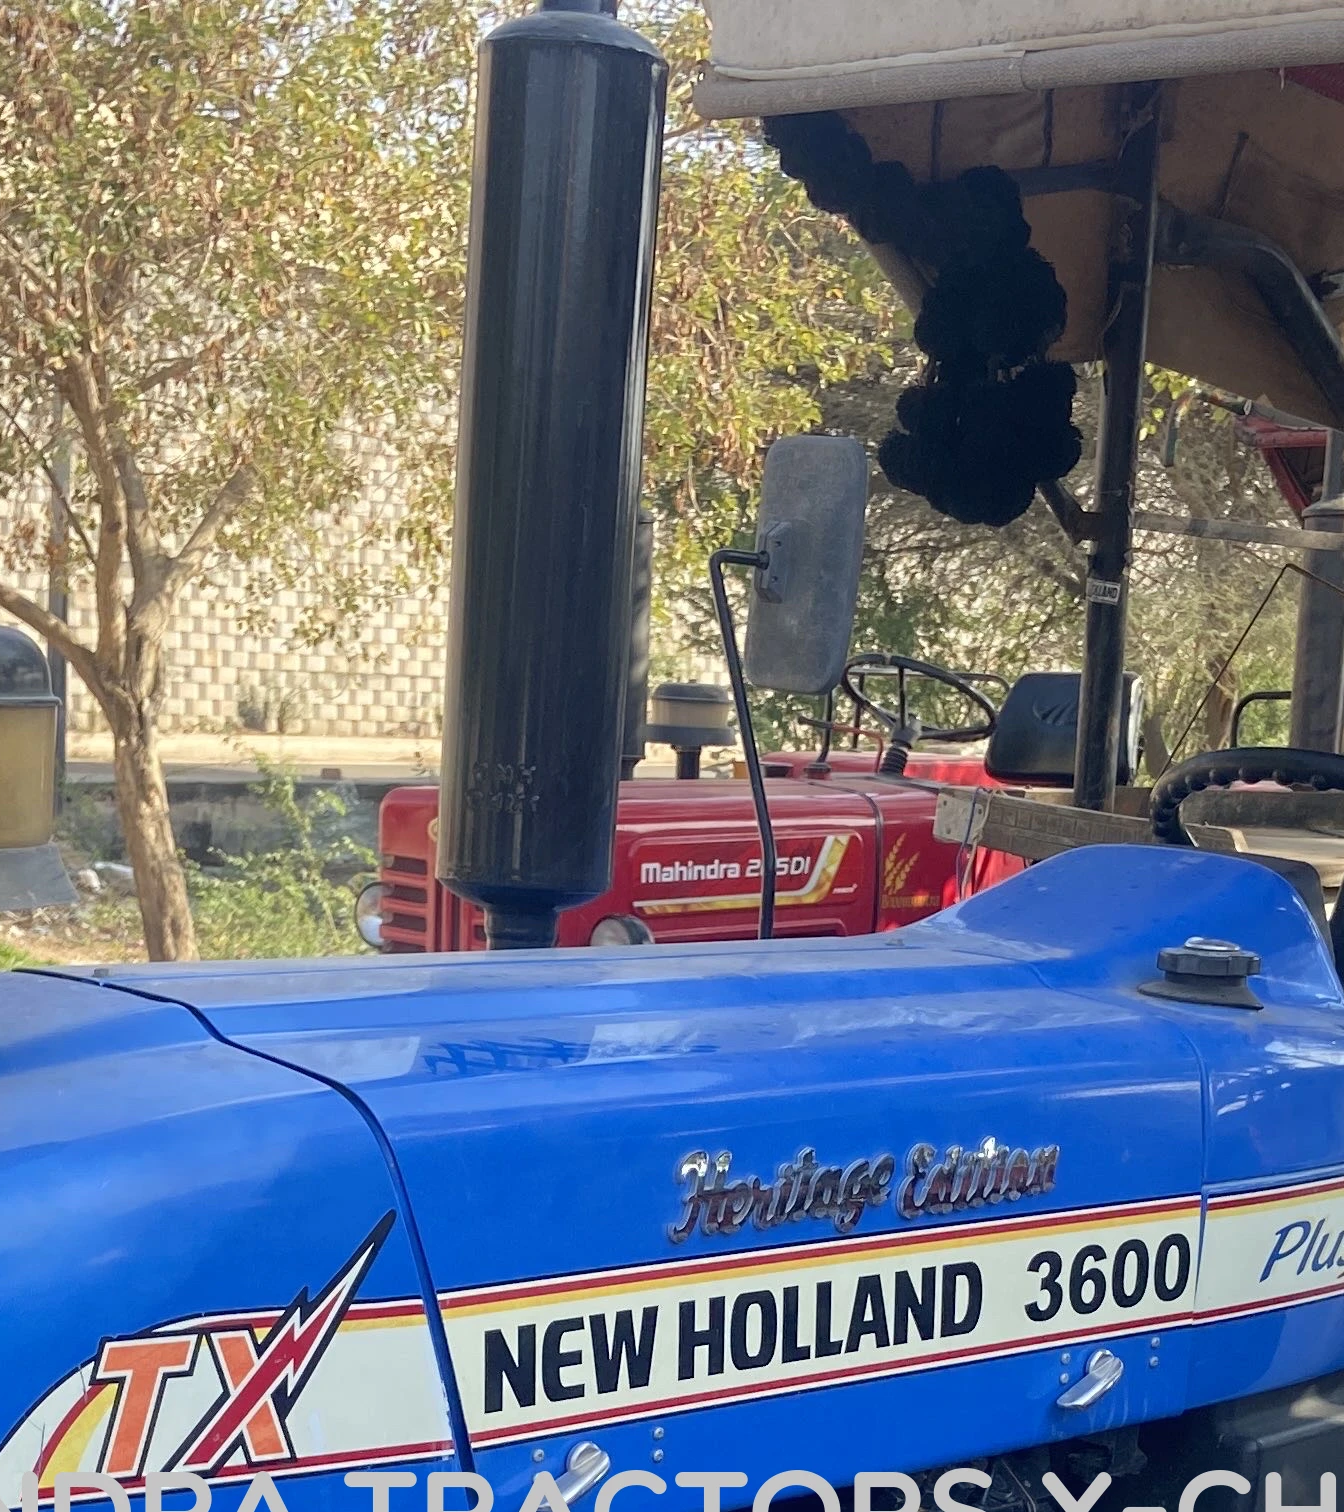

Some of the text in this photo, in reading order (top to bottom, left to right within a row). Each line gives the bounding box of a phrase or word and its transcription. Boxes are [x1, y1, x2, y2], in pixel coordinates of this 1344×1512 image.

[640, 855, 812, 884] Mahindra 25DI
[667, 1135, 1061, 1244] Heritage Edition
[89, 1209, 398, 1481] TX
[483, 1233, 1192, 1414] NEW HOLLAND 3600
